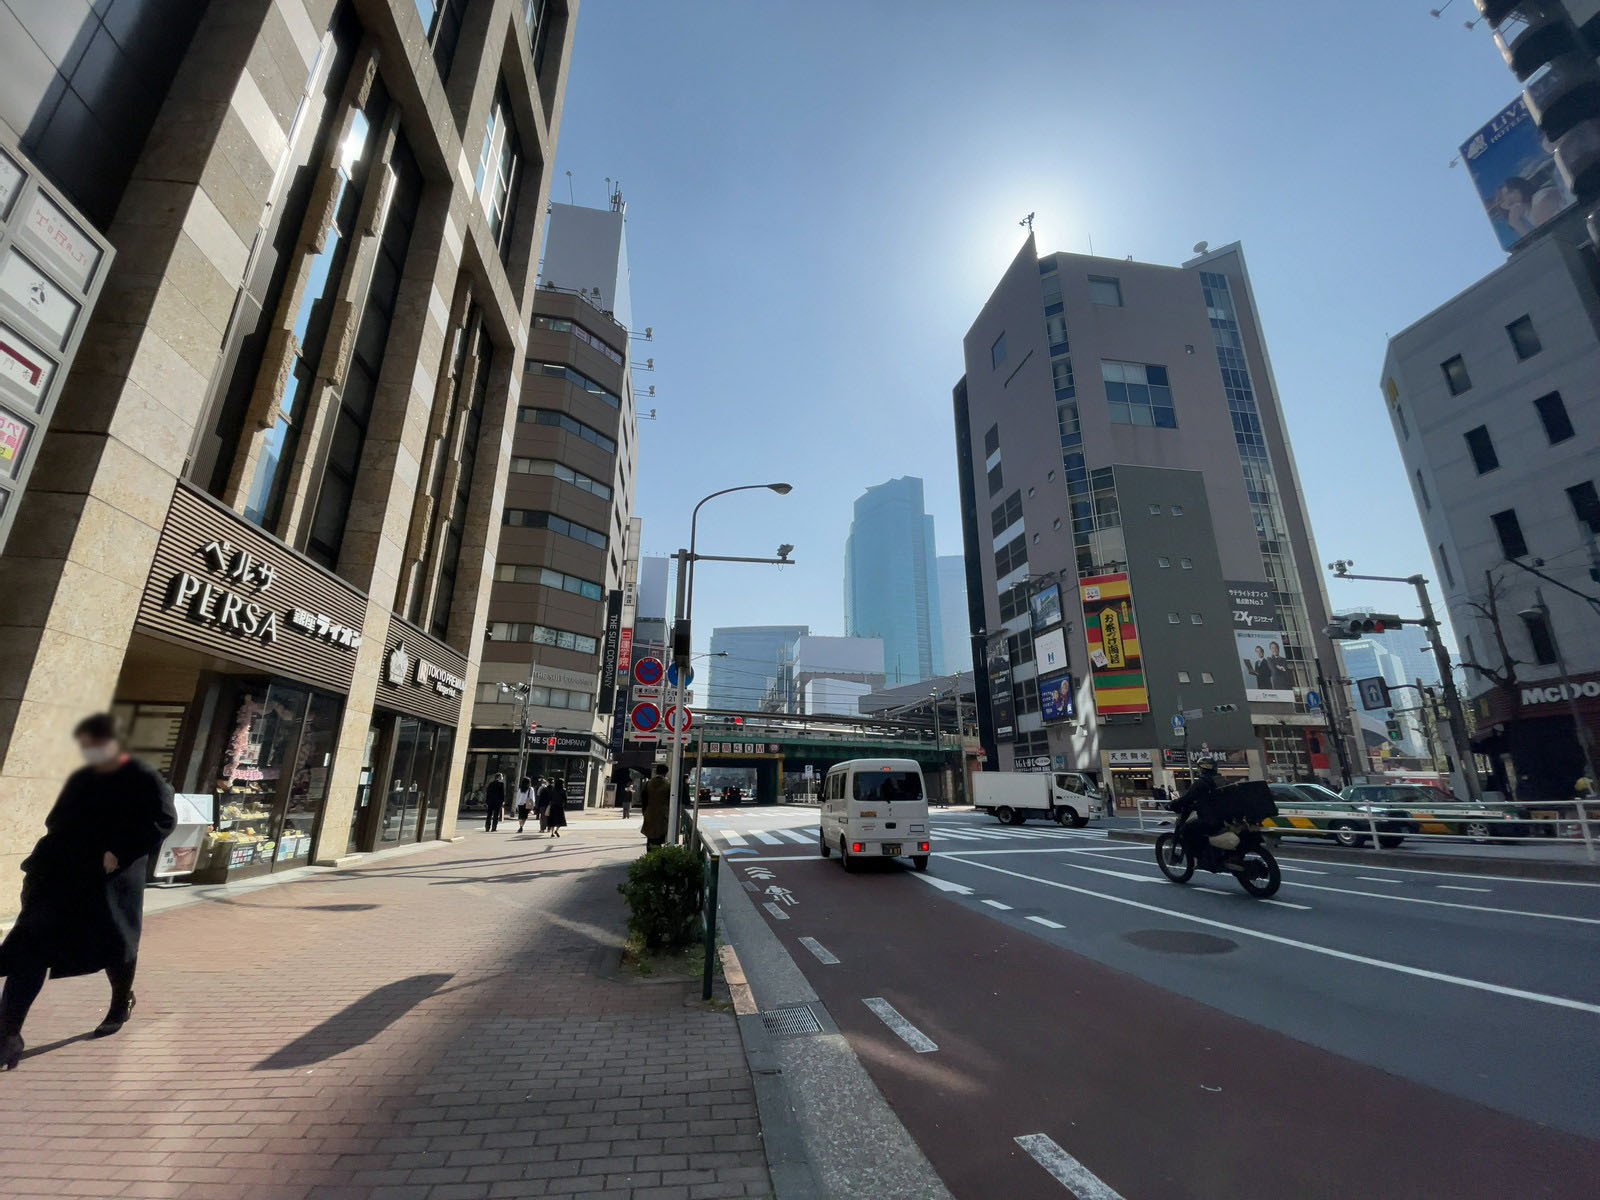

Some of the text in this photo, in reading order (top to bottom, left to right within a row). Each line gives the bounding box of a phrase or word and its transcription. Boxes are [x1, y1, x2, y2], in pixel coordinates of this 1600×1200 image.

[175, 573, 278, 642] PERSA
[292, 608, 363, 648] 銀座ライオン
[604, 614, 619, 689] THE SUIT COMPANY
[428, 664, 447, 682] TOKYO
[528, 736, 541, 744] THE
[557, 738, 587, 747] COMPANY
